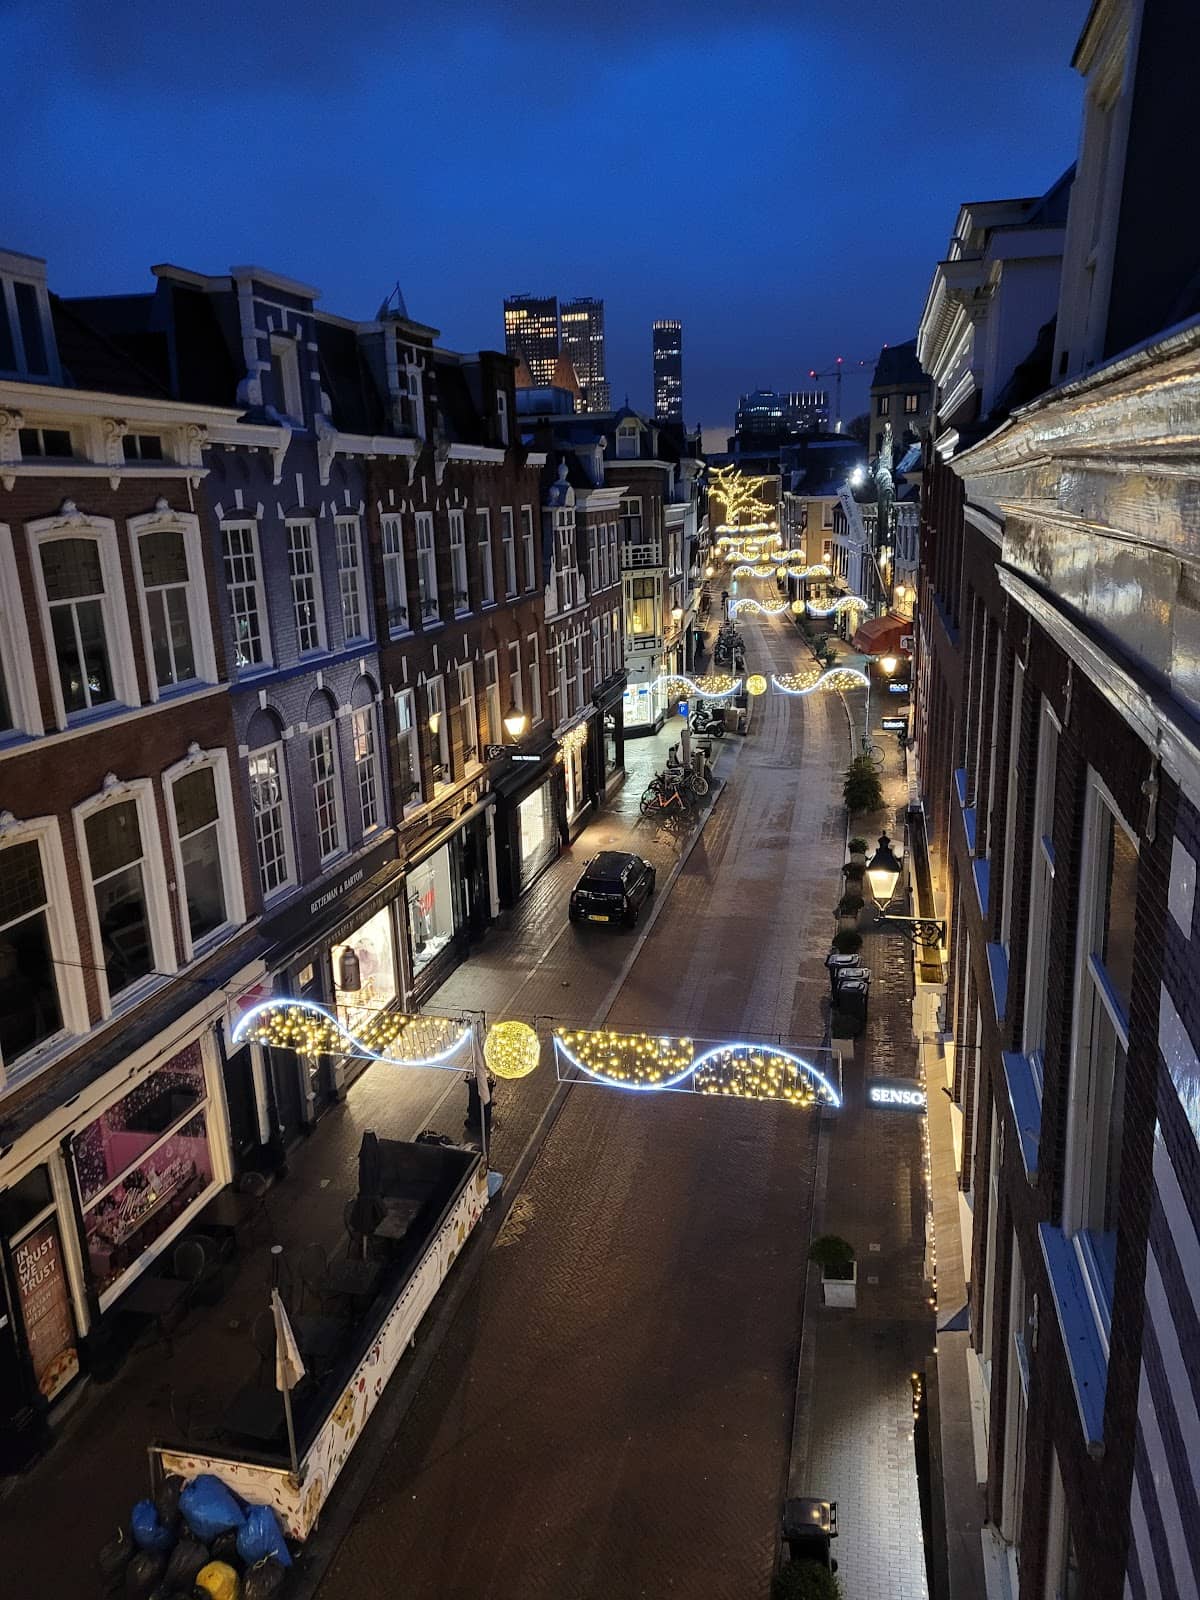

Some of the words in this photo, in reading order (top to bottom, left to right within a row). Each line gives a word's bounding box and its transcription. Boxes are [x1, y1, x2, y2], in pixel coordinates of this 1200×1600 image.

[310, 887, 338, 914] BETJEMAN
[344, 869, 363, 890] BARTON
[871, 1088, 924, 1105] SENSO
[16, 1246, 29, 1264] IN
[18, 1236, 54, 1274] CRUST
[20, 1263, 38, 1284] WE
[22, 1259, 56, 1296] TRUST
